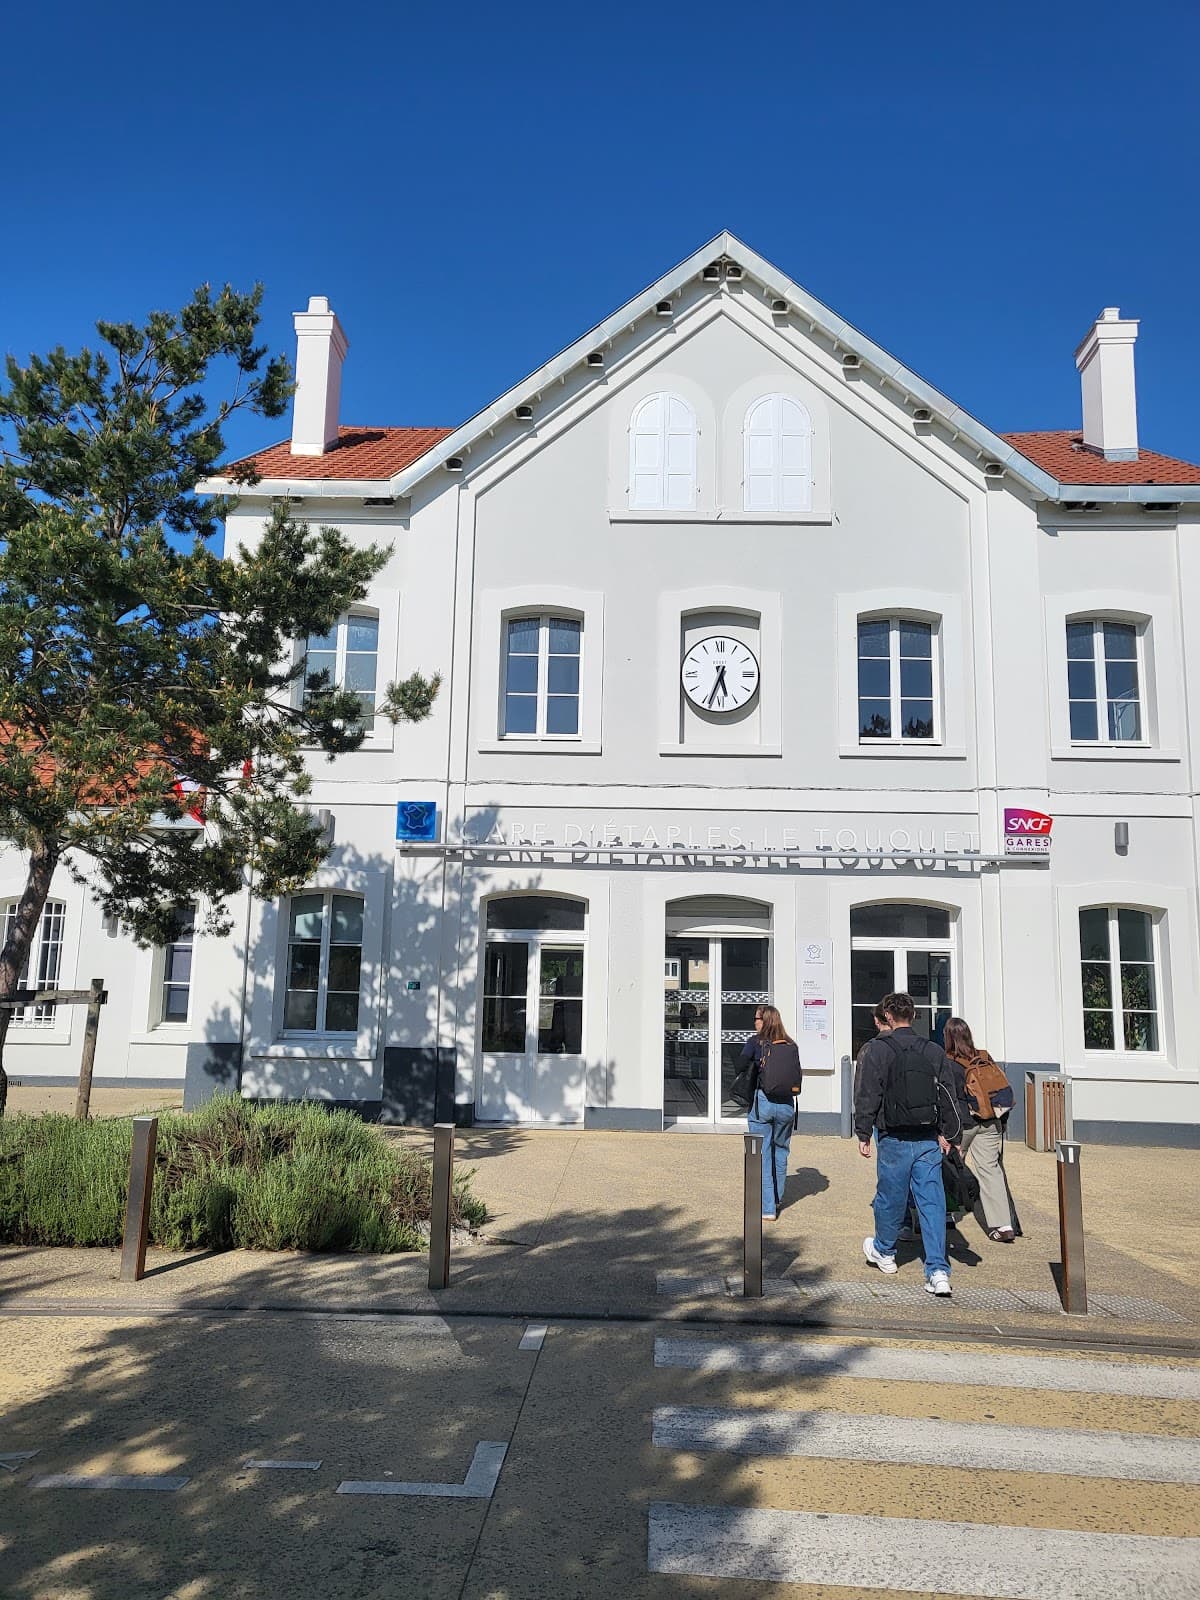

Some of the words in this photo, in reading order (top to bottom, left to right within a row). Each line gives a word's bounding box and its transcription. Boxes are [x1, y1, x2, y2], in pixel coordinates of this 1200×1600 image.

[1007, 817, 1051, 831] SNCF
[462, 821, 547, 846] GARE
[813, 828, 981, 852] TOUQUET
[1006, 838, 1050, 847] GARES
